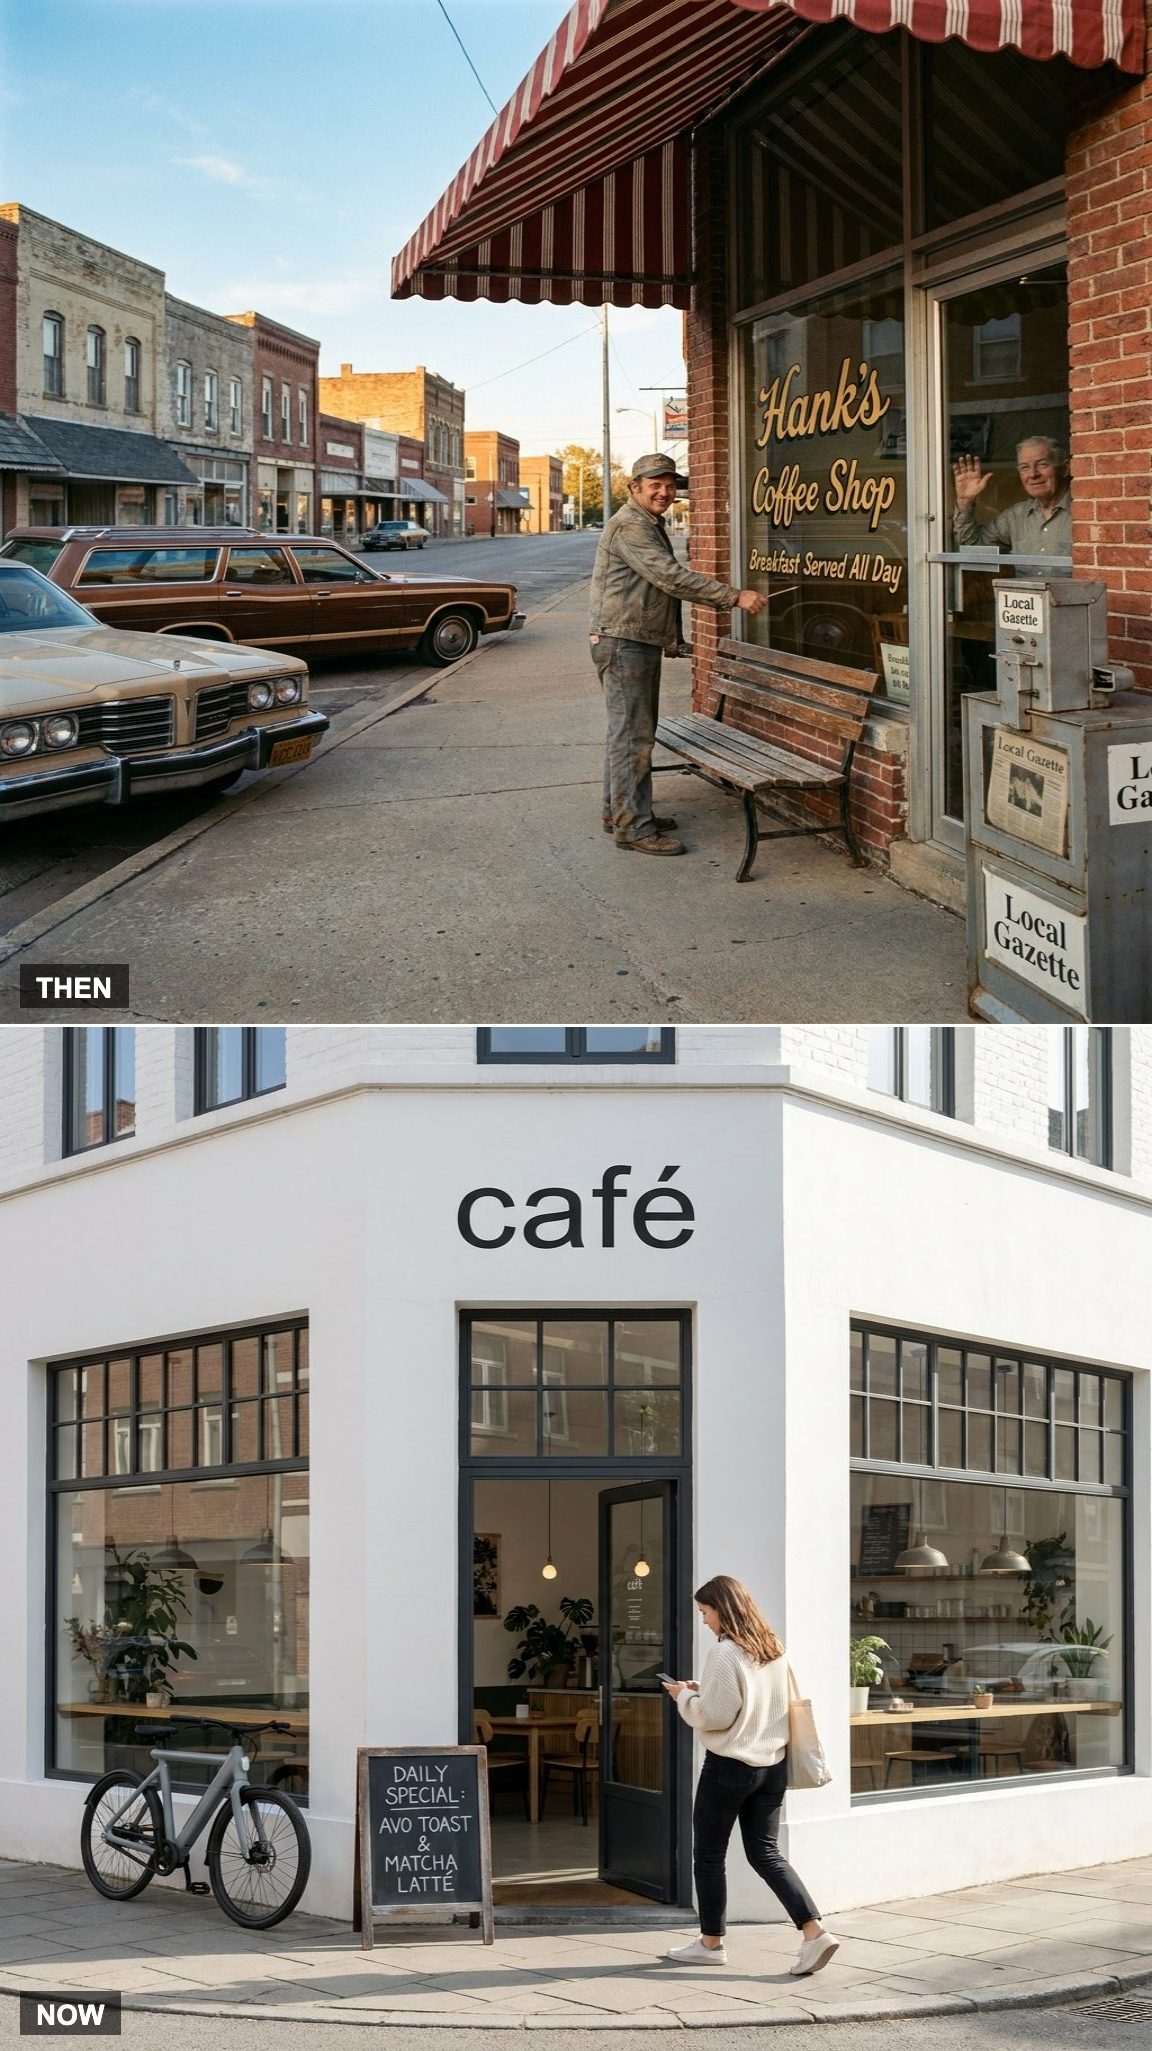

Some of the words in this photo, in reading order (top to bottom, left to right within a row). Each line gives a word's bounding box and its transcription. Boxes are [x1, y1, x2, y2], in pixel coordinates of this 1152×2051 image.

[756, 356, 891, 448] Hank's
[753, 464, 819, 527] Coffee
[825, 457, 896, 529] Shop
[749, 548, 800, 574] Breakfast
[803, 551, 848, 579] Served
[849, 553, 871, 581] All
[871, 554, 903, 594] Day
[1003, 594, 1035, 611] Local
[1004, 893, 1068, 952] Local
[993, 920, 1081, 991] Gazette
[457, 1164, 695, 1250] café
[393, 1764, 448, 1783] DAILY
[385, 1786, 467, 1805] SPECIAL:
[378, 1816, 413, 1834] AVO
[417, 1815, 473, 1833] TOAST
[417, 1834, 431, 1852] &
[385, 1854, 459, 1873] MATCHA
[397, 1869, 456, 1893] LATTÉ
